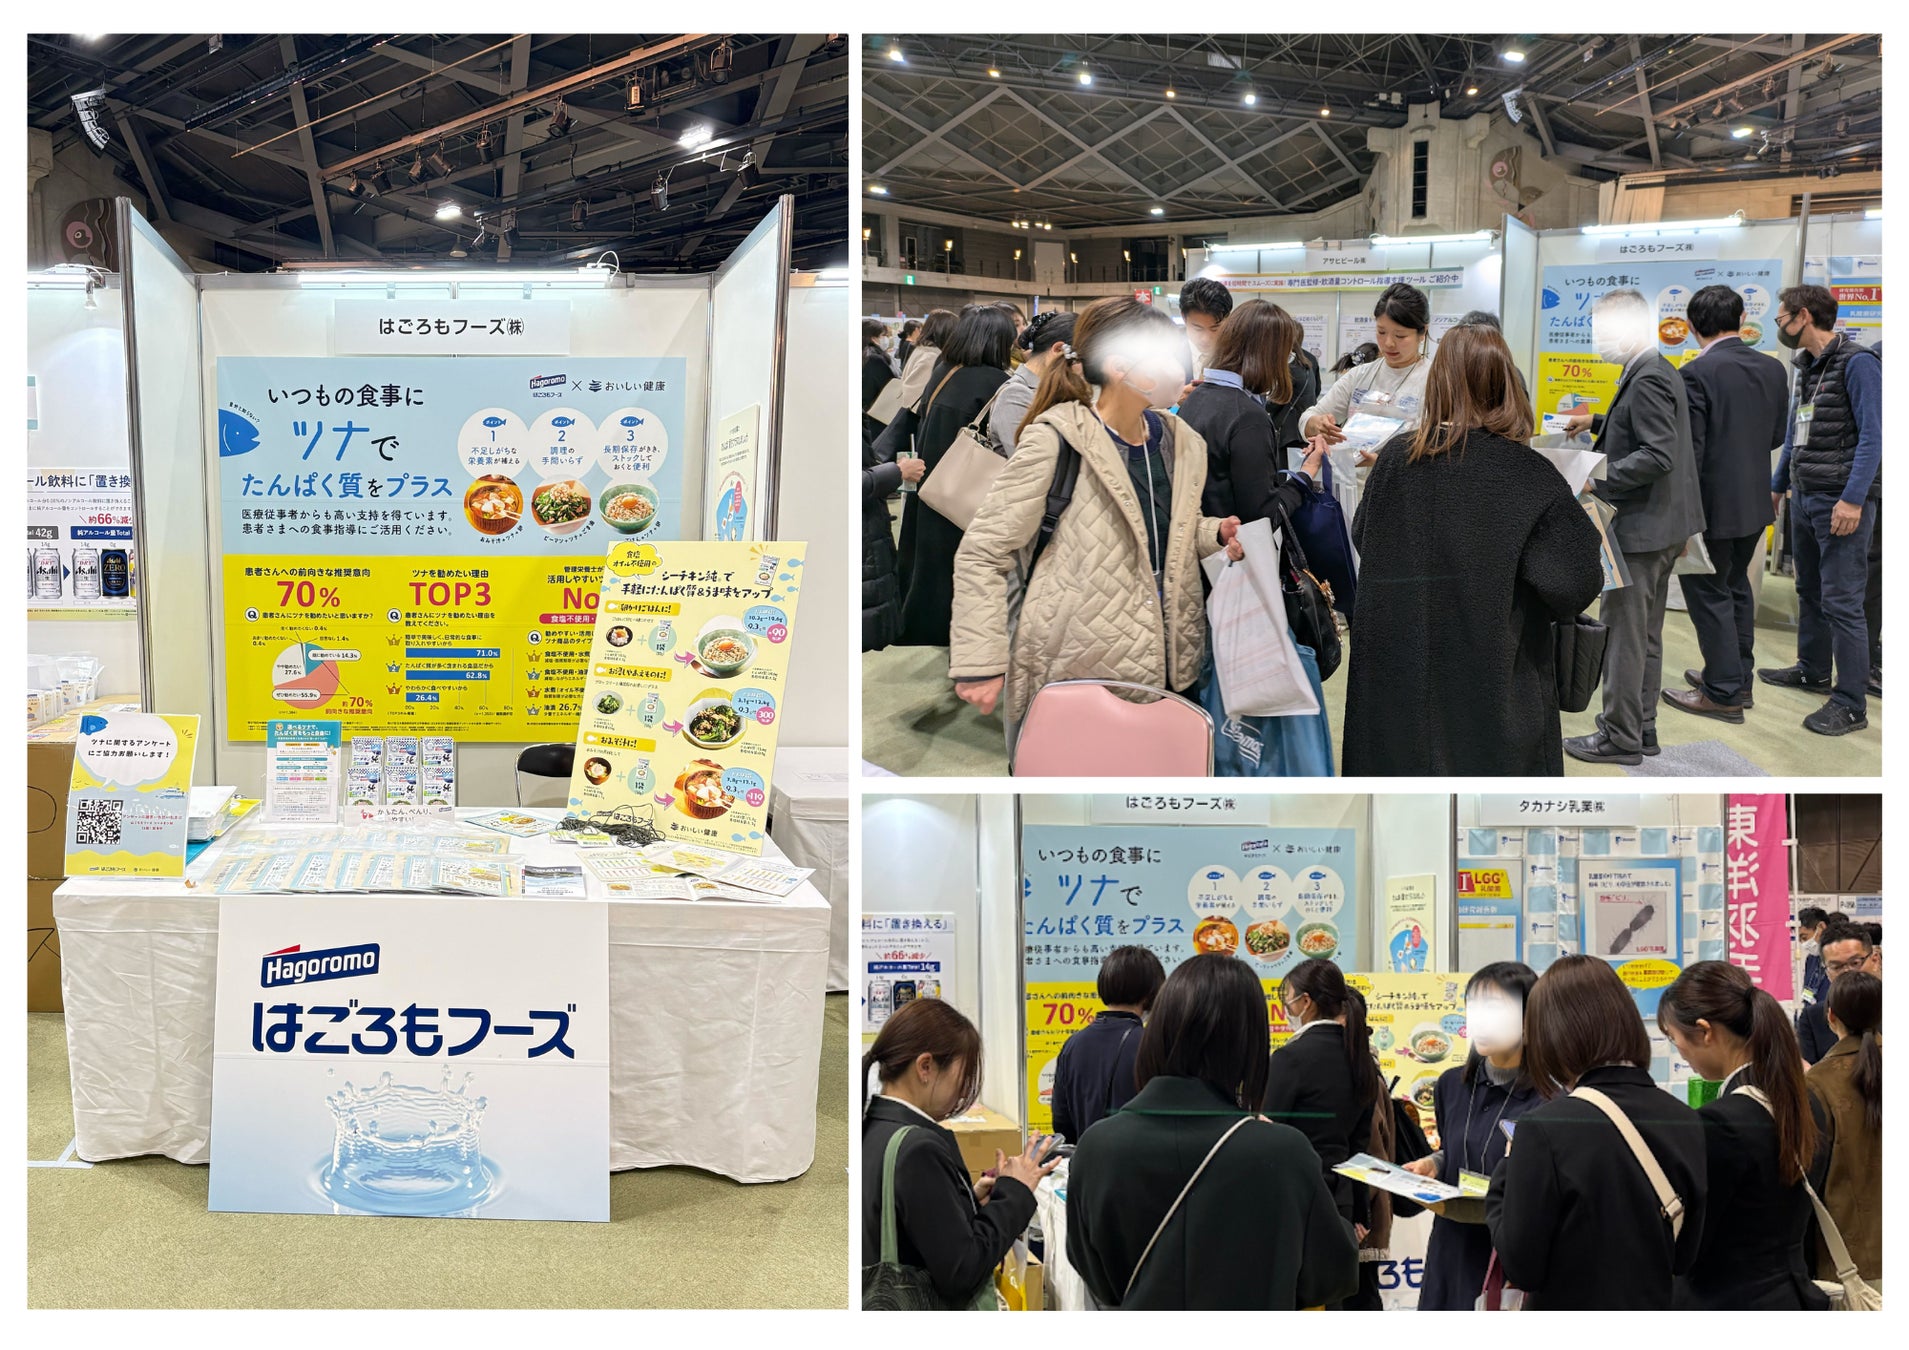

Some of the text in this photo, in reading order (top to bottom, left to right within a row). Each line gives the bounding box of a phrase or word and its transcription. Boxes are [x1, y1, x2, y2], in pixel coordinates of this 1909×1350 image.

[1565, 275, 1640, 287] いつもの食事に
[1562, 364, 1593, 377] 70%
[531, 375, 566, 389] Hagoromo
[605, 380, 666, 392] おいしい健康
[268, 384, 424, 407] いつもの食事に
[293, 420, 400, 461] ツナで
[491, 430, 496, 442] 1
[558, 430, 566, 442] 2
[626, 430, 635, 442] 3
[471, 447, 518, 455] 不足しがちな
[550, 446, 575, 455] 調理の
[468, 456, 520, 465] 栄養素が補える
[541, 456, 584, 465] 手間いらず
[612, 453, 652, 462] ストックして
[613, 462, 651, 472] おくと便利
[242, 472, 453, 498] たんぱく質をプラス
[241, 509, 453, 521] 医療従事者からも高い支持を得ています。
[35, 528, 53, 539] 42g
[241, 523, 453, 536] 患者さまへの食事指導にご活用ください。
[245, 567, 371, 577] 患者さんへの前向きな推奨意向
[412, 569, 490, 579] ツナを勧めたい理由
[277, 580, 341, 607] 70%
[409, 582, 492, 607] TOP3
[621, 583, 774, 598] 手軽にたんぱく質&うま味をアップ
[247, 610, 258, 619] Q
[262, 612, 374, 620] 患者さんにツナを勧めたいと思いますか?
[389, 611, 400, 620] Q
[405, 620, 450, 628] 教えてください。
[530, 633, 540, 642] Q
[476, 649, 499, 657] 71.0%
[415, 694, 438, 702] 26.4%
[91, 739, 171, 747] ツナに関するアンケート
[680, 825, 719, 837] おいしい健康
[1038, 846, 1161, 864] いつもの食事に
[1474, 872, 1501, 885] LGG
[1058, 874, 1143, 906] ツナで
[1263, 881, 1270, 891] 2
[1313, 881, 1321, 891] 3
[265, 950, 376, 985] Hagoromo
[1043, 1003, 1095, 1025] 70%
[252, 999, 577, 1060] はごろもフーズ
